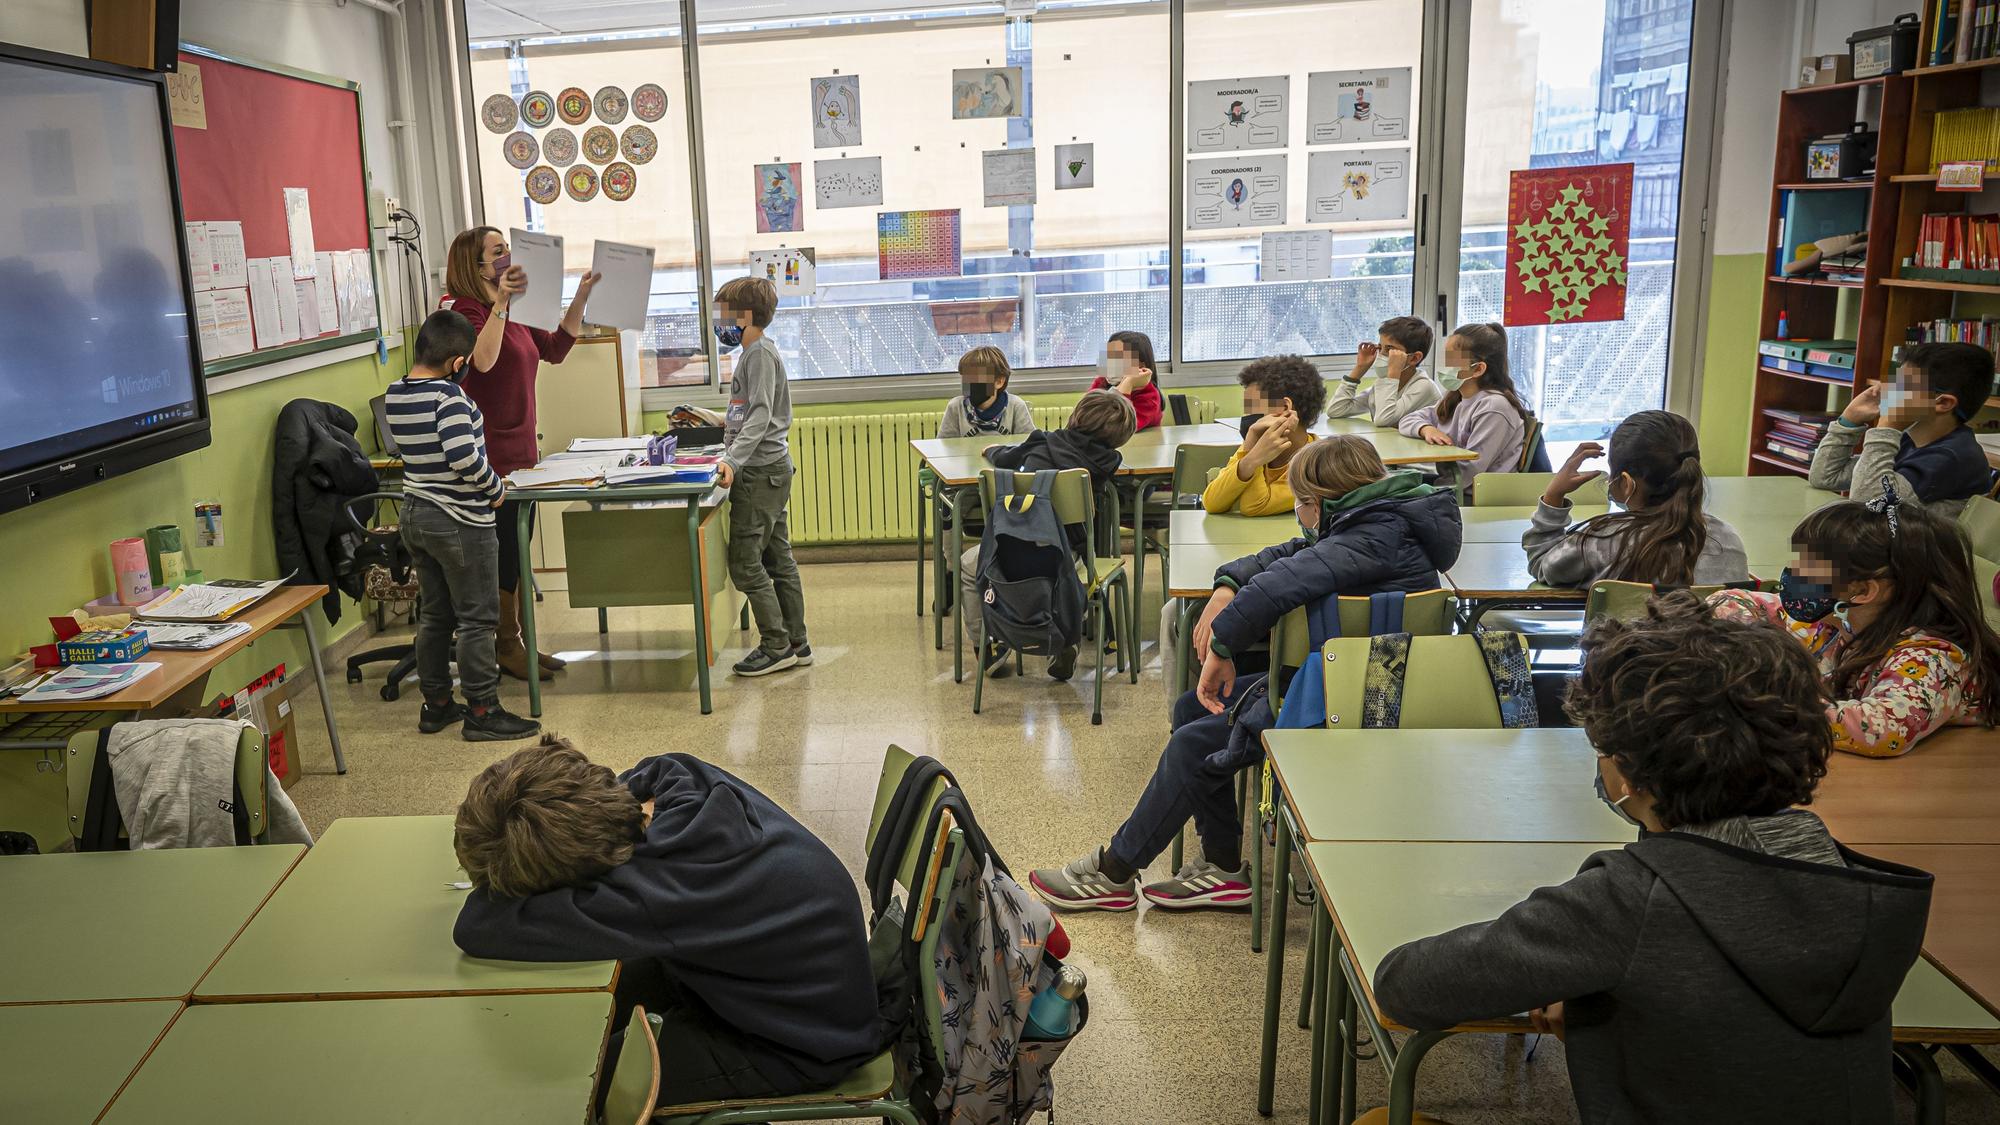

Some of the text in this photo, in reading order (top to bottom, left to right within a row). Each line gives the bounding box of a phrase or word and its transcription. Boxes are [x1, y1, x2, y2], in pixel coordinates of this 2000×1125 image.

[1217, 88, 1259, 96] MODERADOR/A
[1211, 167, 1253, 175] COORDINADORS
[120, 369, 171, 397] Windows 10
[131, 639, 143, 649] HALLI
[132, 645, 144, 655] GALLI
